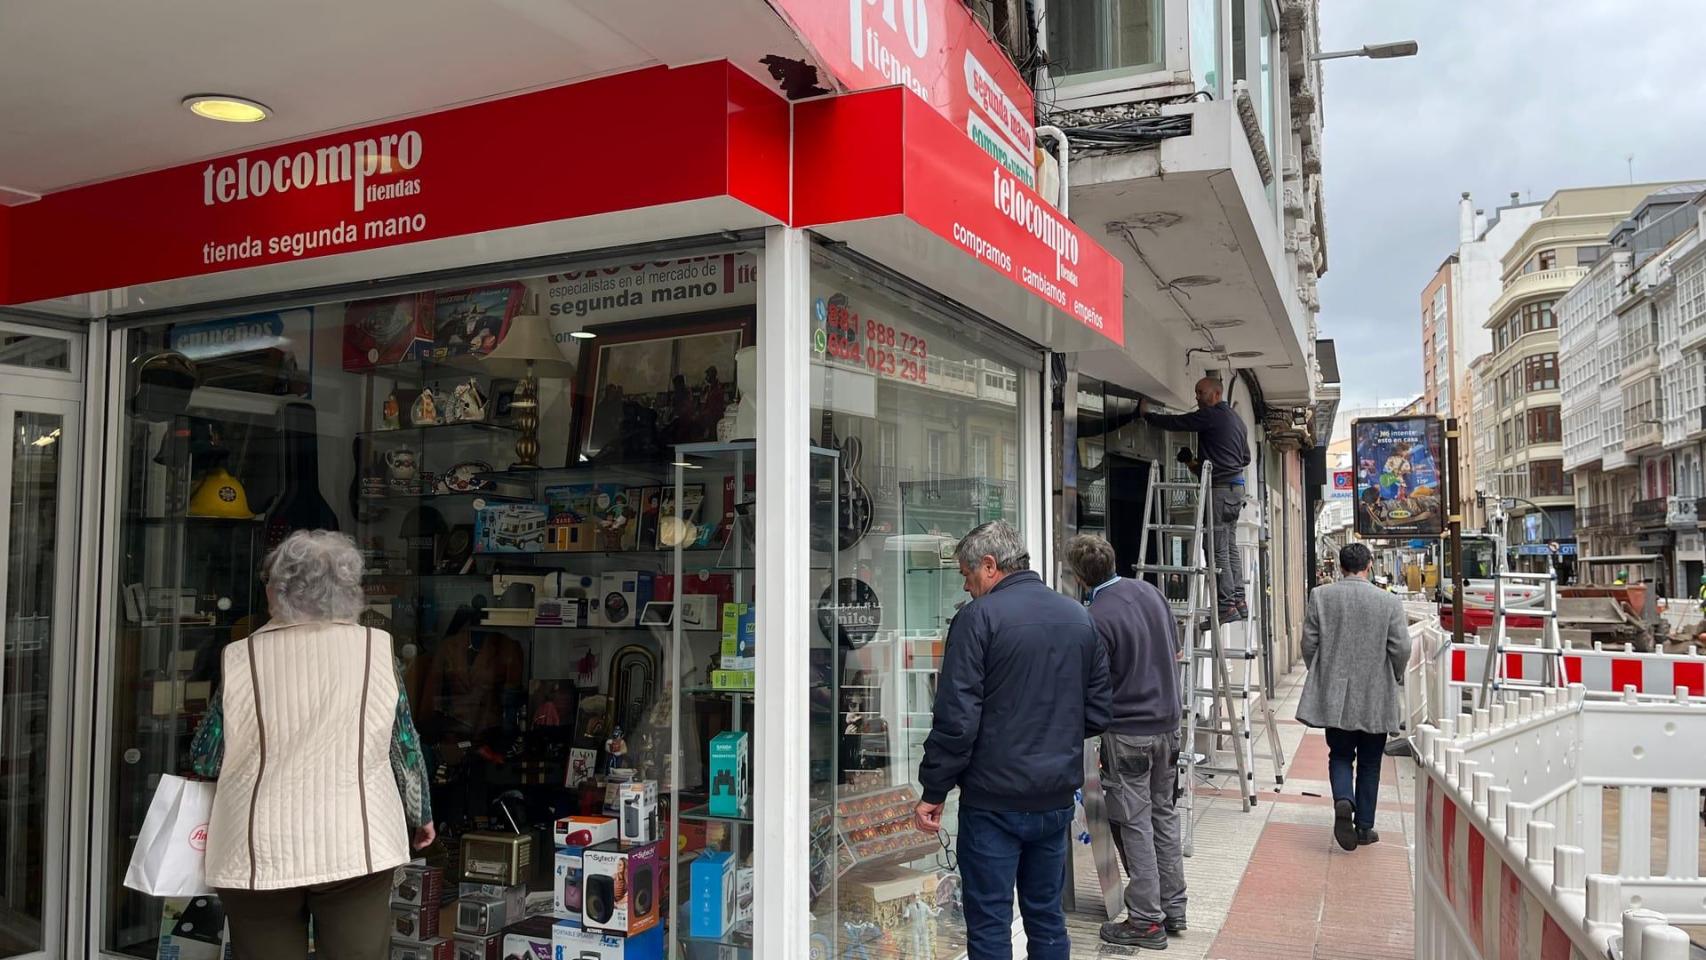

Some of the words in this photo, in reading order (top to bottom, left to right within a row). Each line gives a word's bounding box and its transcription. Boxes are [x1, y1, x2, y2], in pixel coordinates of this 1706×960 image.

[973, 69, 1009, 128] segunda
[1010, 111, 1031, 152] mano
[203, 130, 423, 212] telocompro
[366, 178, 421, 203] tiendas
[203, 235, 262, 264] tienda
[268, 220, 357, 256] segunda
[364, 213, 426, 240] mano
[993, 166, 1079, 282] telocompro
[549, 276, 616, 298] especialistas
[619, 278, 633, 288] en
[636, 274, 645, 286] el
[649, 266, 699, 284] mercado
[702, 262, 717, 276] de
[953, 222, 1012, 273] compramos
[1022, 266, 1066, 306] cambiamos
[1074, 299, 1103, 329] empeños
[550, 289, 643, 317] segunda
[652, 282, 718, 303] mano
[866, 319, 895, 347] 888
[900, 332, 926, 358] 723
[866, 346, 896, 375] 023
[900, 358, 926, 384] 294
